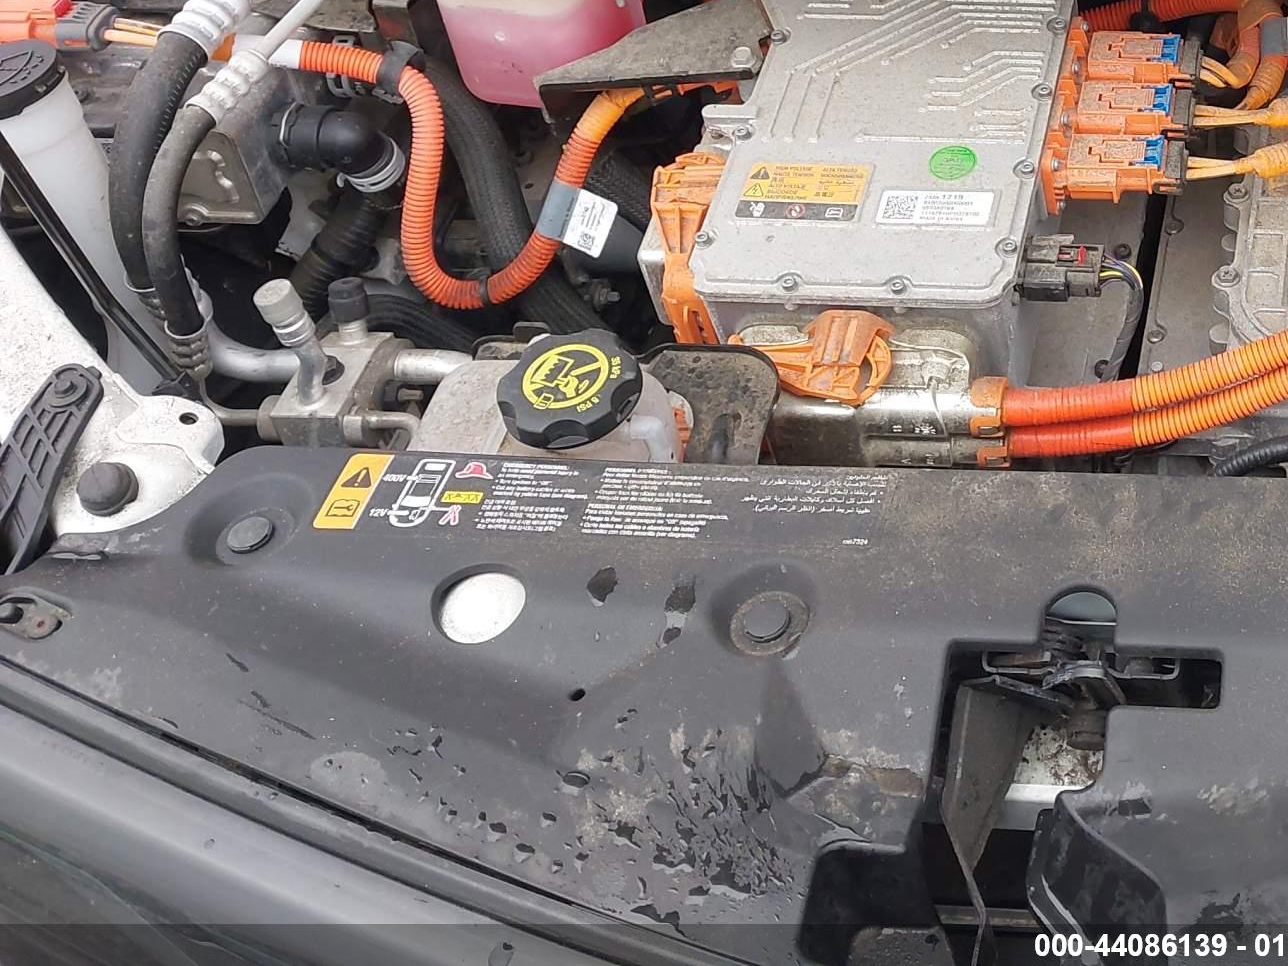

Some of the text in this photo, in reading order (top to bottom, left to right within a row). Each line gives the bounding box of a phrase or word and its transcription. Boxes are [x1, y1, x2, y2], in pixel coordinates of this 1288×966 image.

[576, 400, 593, 413] PSI
[383, 474, 406, 482] 400V
[369, 507, 388, 517] 12V
